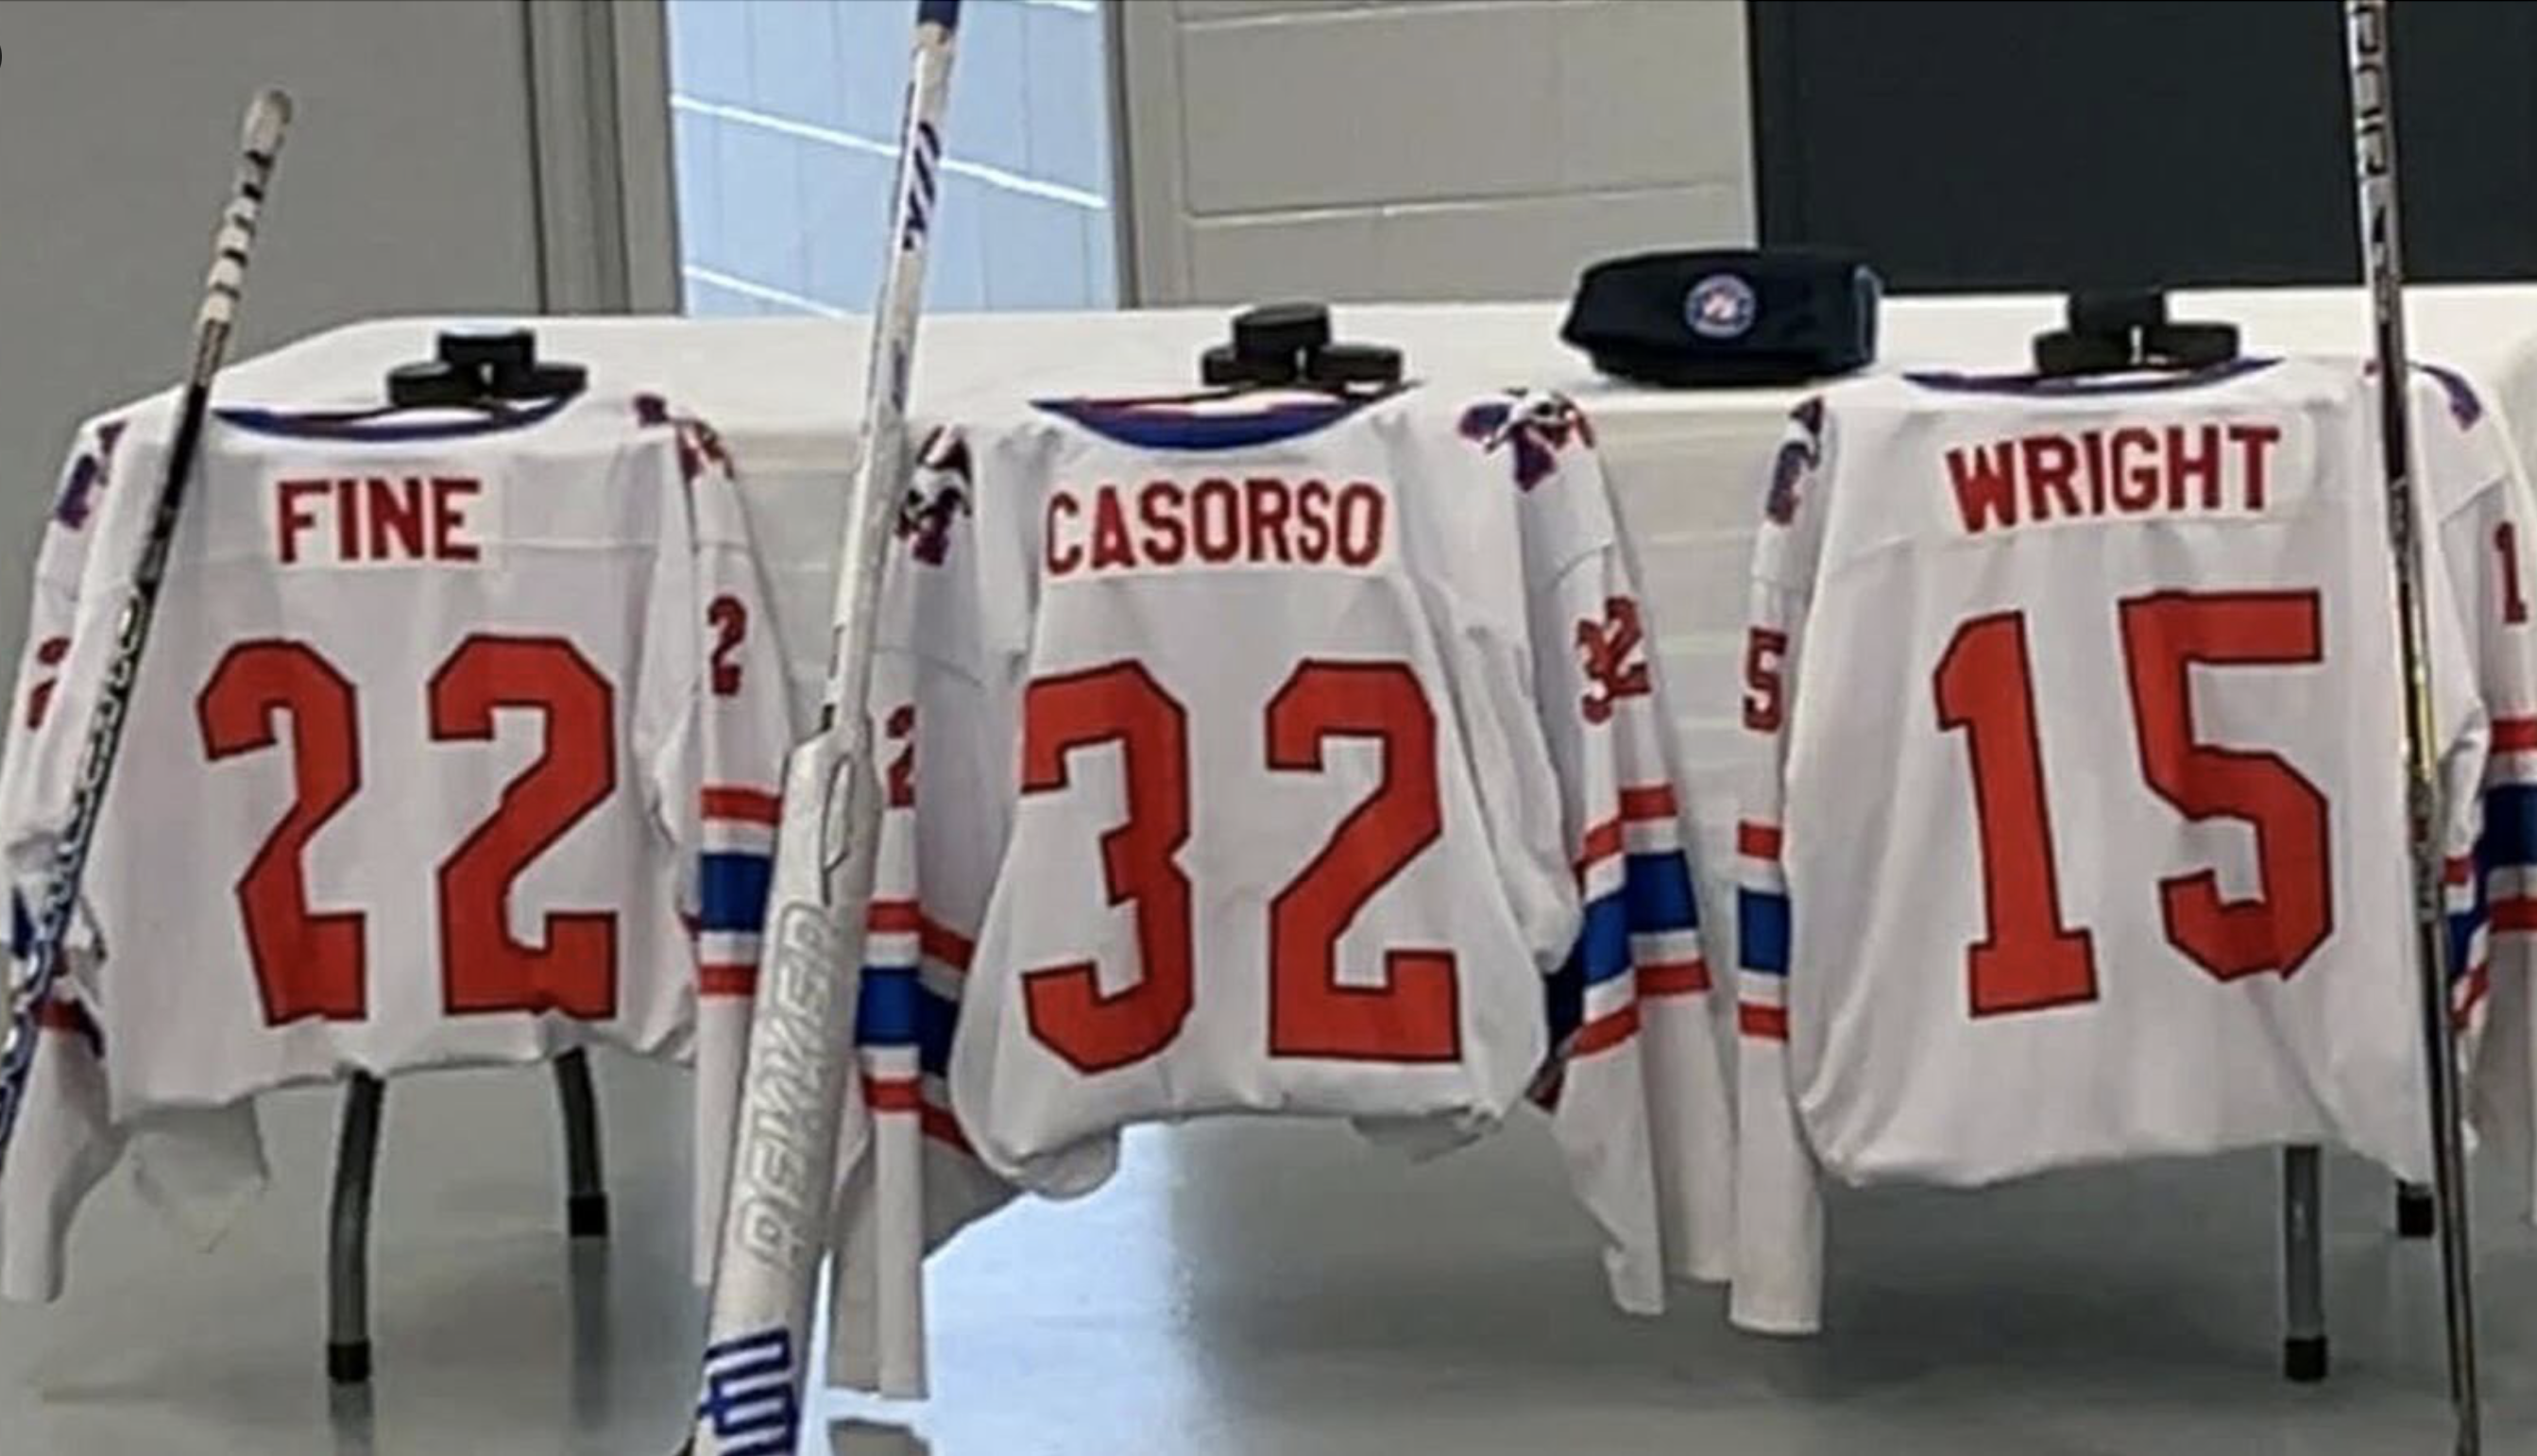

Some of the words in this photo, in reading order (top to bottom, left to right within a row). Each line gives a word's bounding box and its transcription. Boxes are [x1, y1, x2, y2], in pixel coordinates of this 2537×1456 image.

[277, 477, 482, 566] FINE
[1046, 479, 1386, 577] CASORSO
[1945, 424, 2280, 534] WRIGHT
[2494, 520, 2528, 625] 1
[707, 595, 748, 698] 2
[1575, 595, 1652, 726] 32
[1743, 625, 1788, 735] 5
[196, 634, 617, 1027] 22
[1932, 588, 2334, 1019] 15
[1021, 659, 1462, 1074] 32
